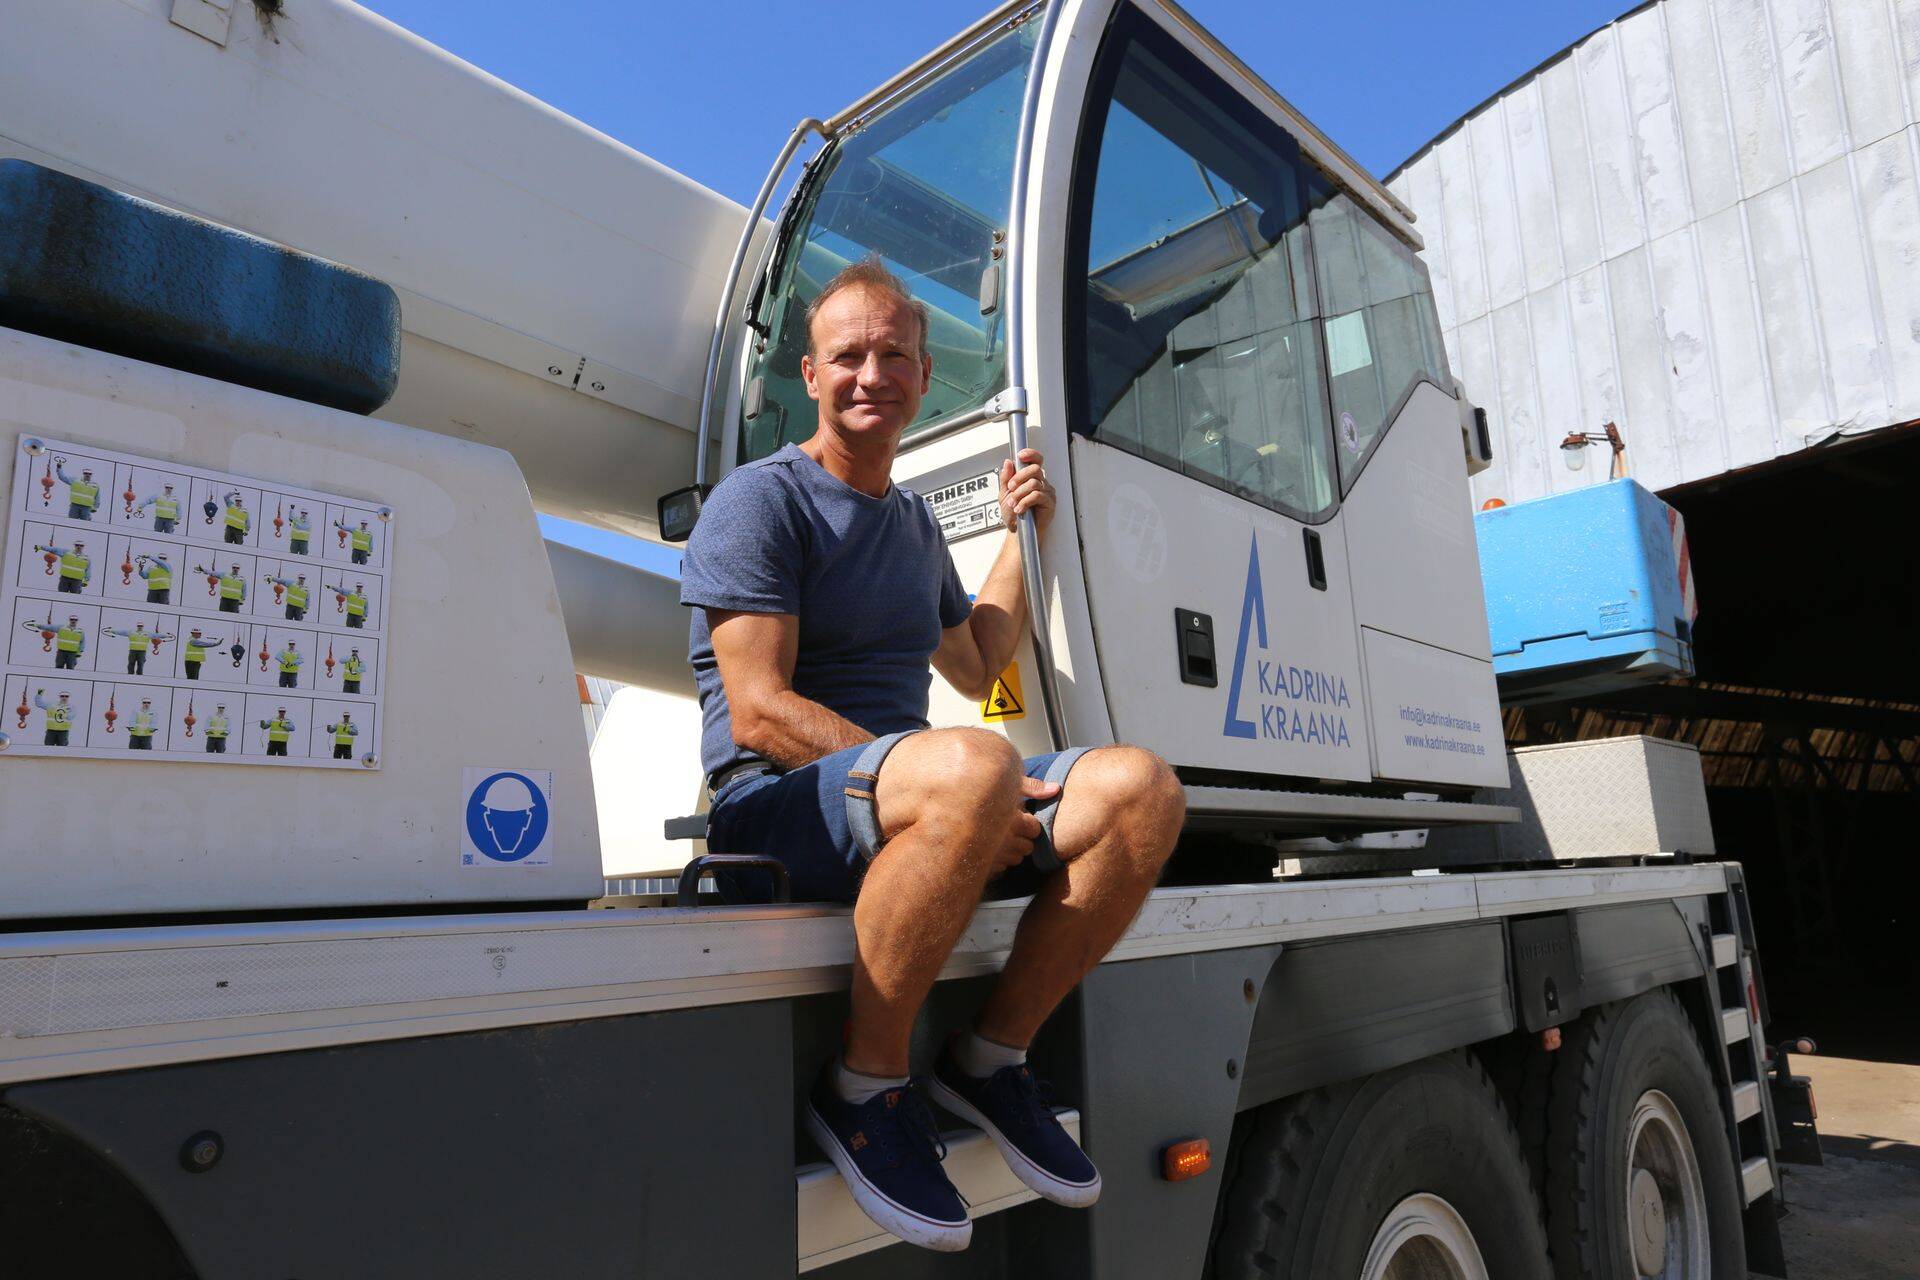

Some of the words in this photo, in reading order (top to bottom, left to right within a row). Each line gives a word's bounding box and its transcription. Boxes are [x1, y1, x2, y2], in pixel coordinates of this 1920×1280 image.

[925, 476, 989, 505] EBHERR
[1257, 660, 1351, 709] KADRINA
[1261, 703, 1351, 748] KRAANA
[1399, 704, 1481, 733] info@kadrinakraana.ee
[1404, 734, 1486, 756] www.kadrinakraana.ee
